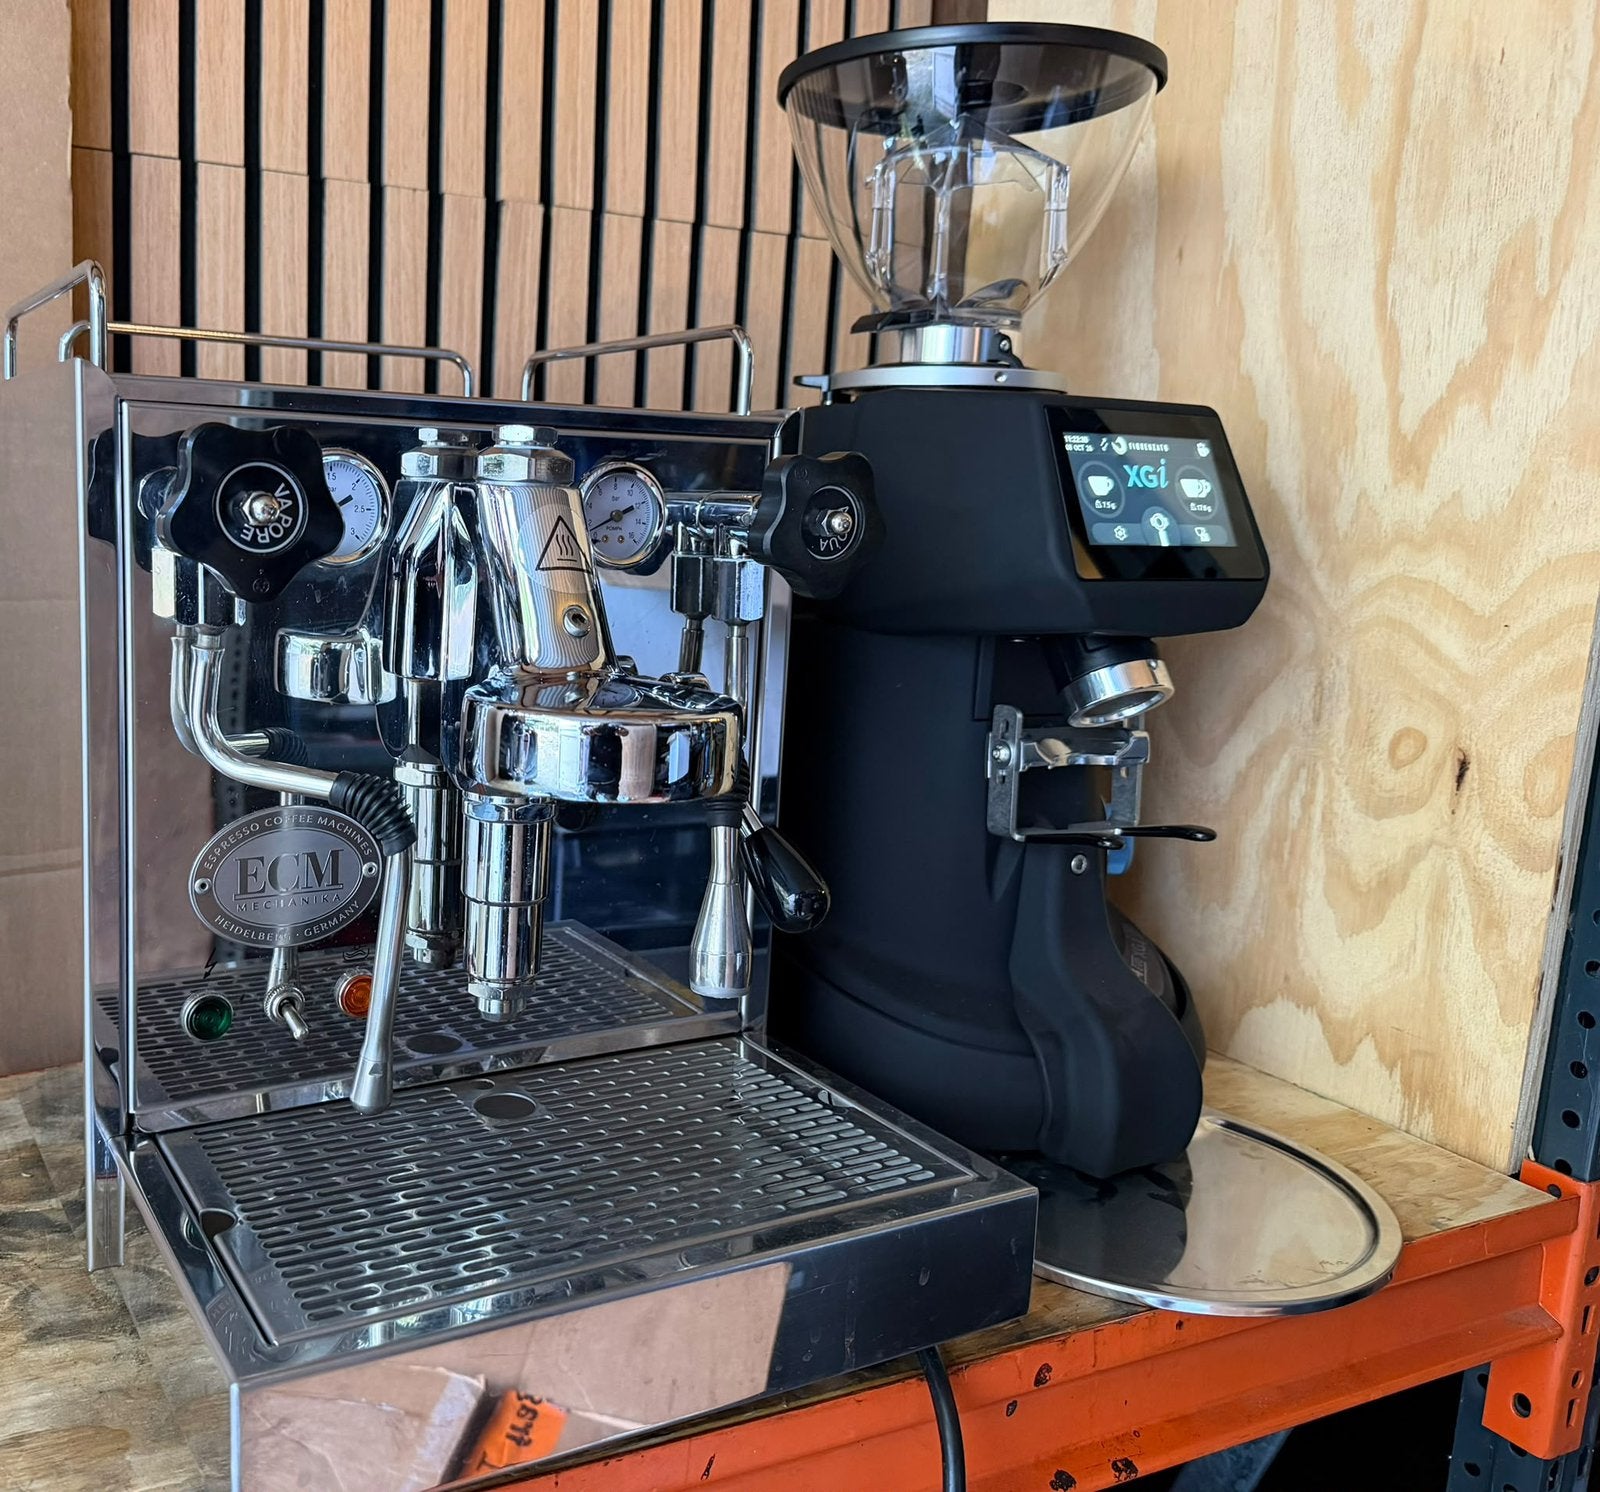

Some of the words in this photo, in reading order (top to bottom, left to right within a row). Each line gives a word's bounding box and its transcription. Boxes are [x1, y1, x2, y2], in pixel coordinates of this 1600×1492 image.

[240, 482, 293, 544] VAPORE
[354, 504, 365, 513] 2.5
[204, 822, 260, 870] ESPRESSO
[264, 814, 314, 827] COFFEE
[317, 815, 373, 857] MACHINES
[234, 849, 345, 895] ECM
[236, 893, 342, 913] MECHANIKA
[304, 900, 361, 938] GERMANY
